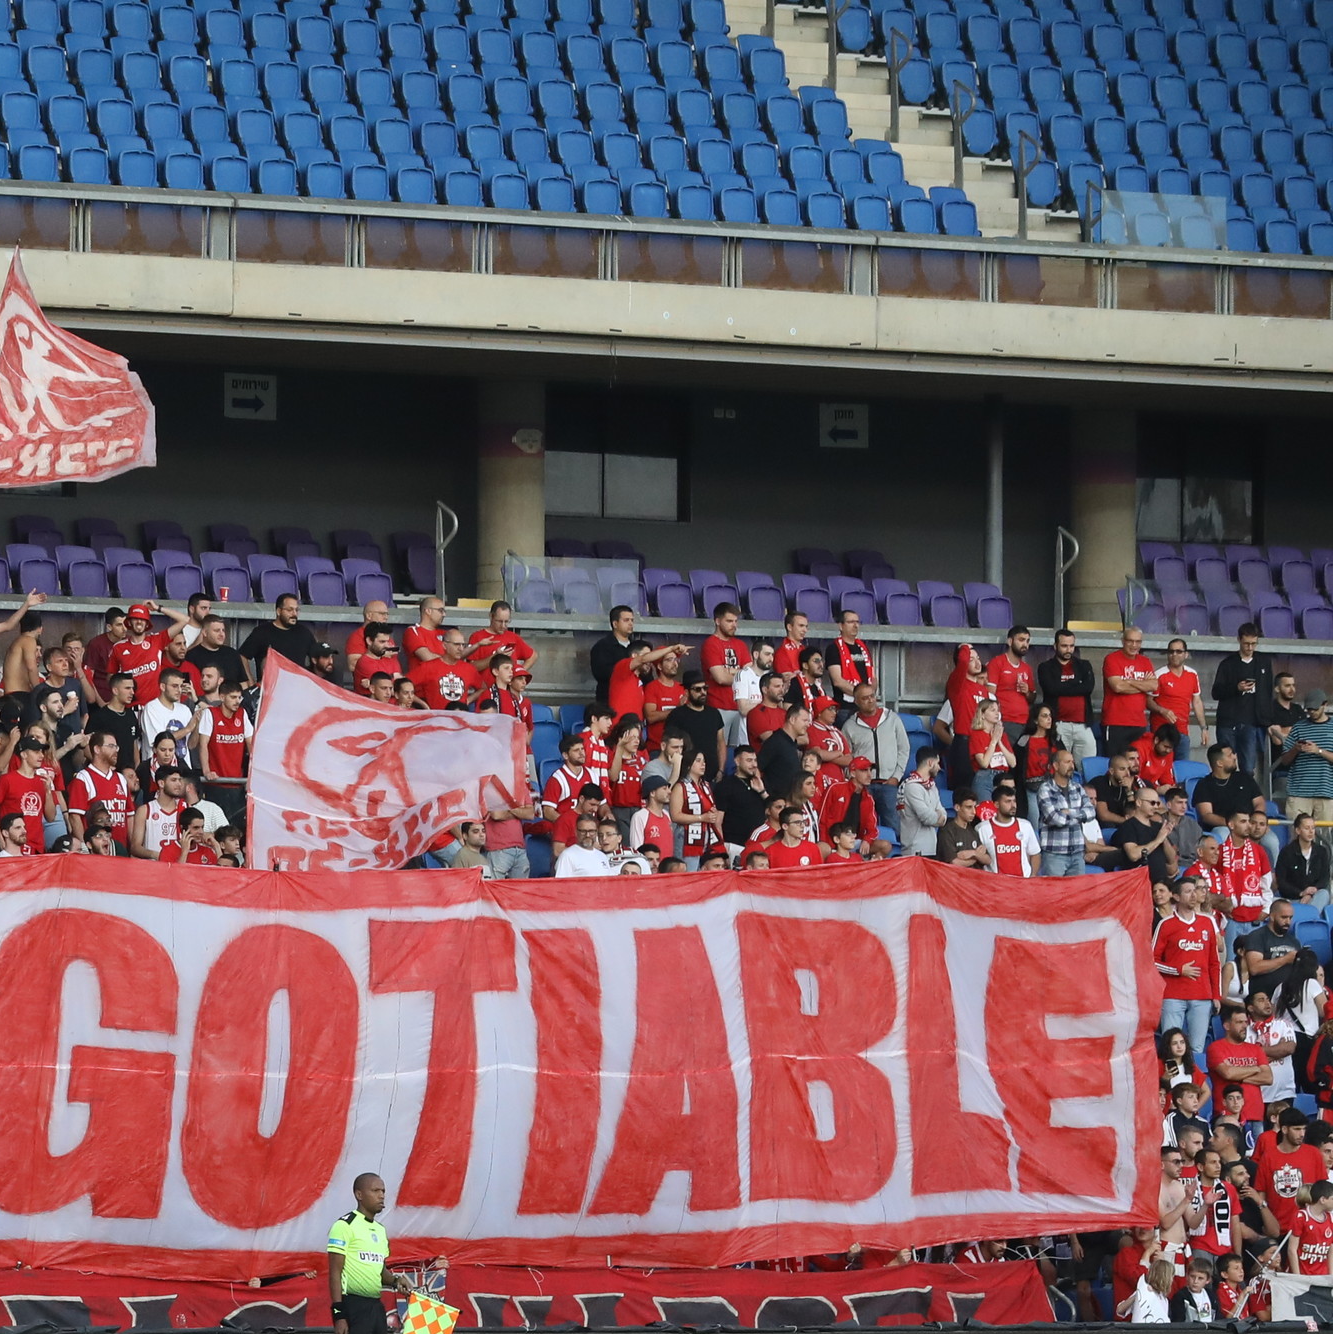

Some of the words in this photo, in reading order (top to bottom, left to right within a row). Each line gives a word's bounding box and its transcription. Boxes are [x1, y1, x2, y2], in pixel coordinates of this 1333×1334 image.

[231, 378, 270, 391] שירותים
[161, 822, 177, 836] 97
[1178, 938, 1205, 951] Carlsberg
